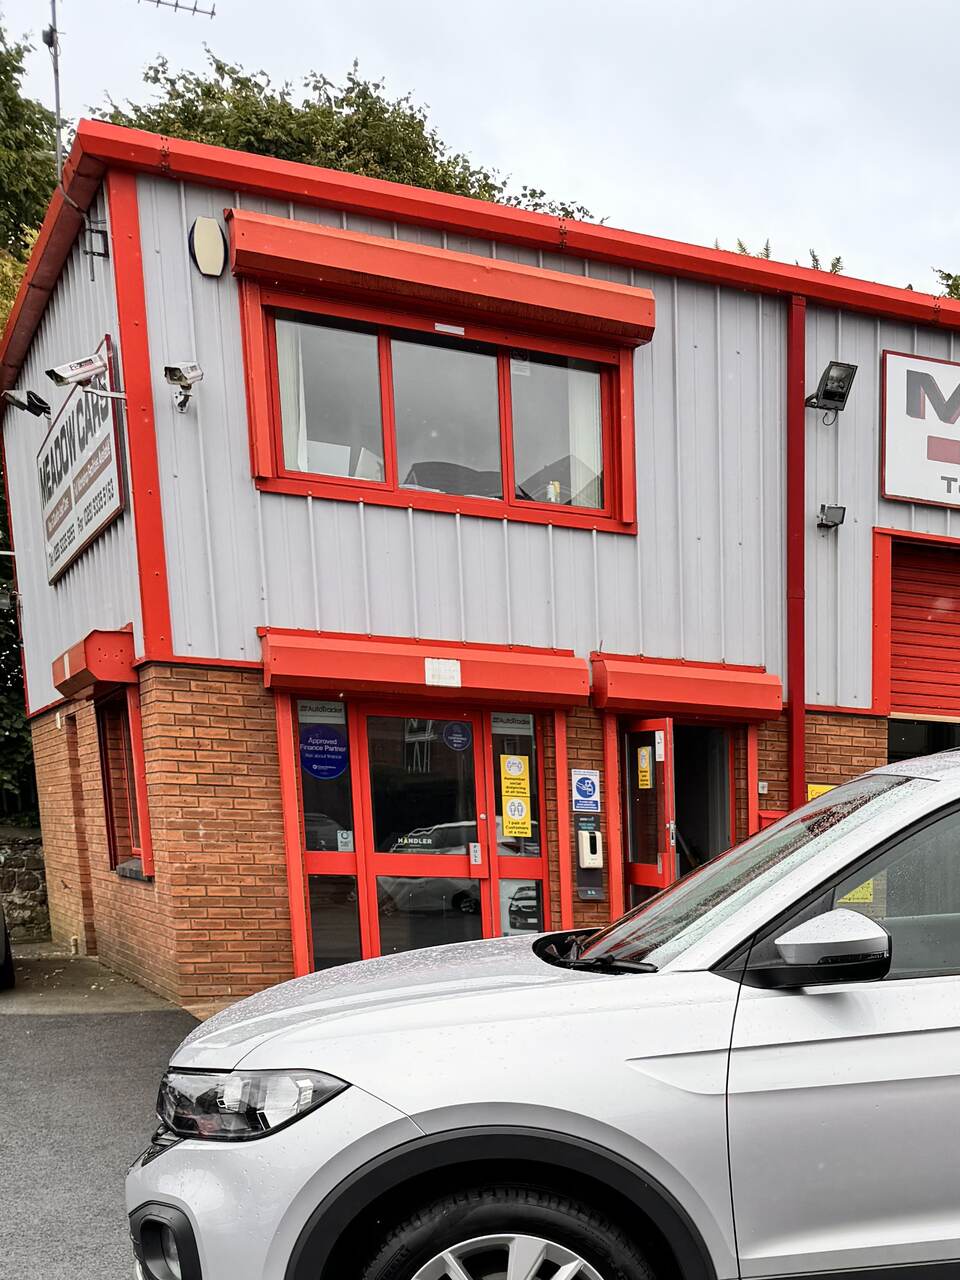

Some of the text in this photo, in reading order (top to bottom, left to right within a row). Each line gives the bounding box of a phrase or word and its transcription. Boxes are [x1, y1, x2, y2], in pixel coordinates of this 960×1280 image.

[39, 409, 78, 510] MEADOW
[308, 737, 337, 745] Approved
[300, 744, 346, 753] Finance Partner
